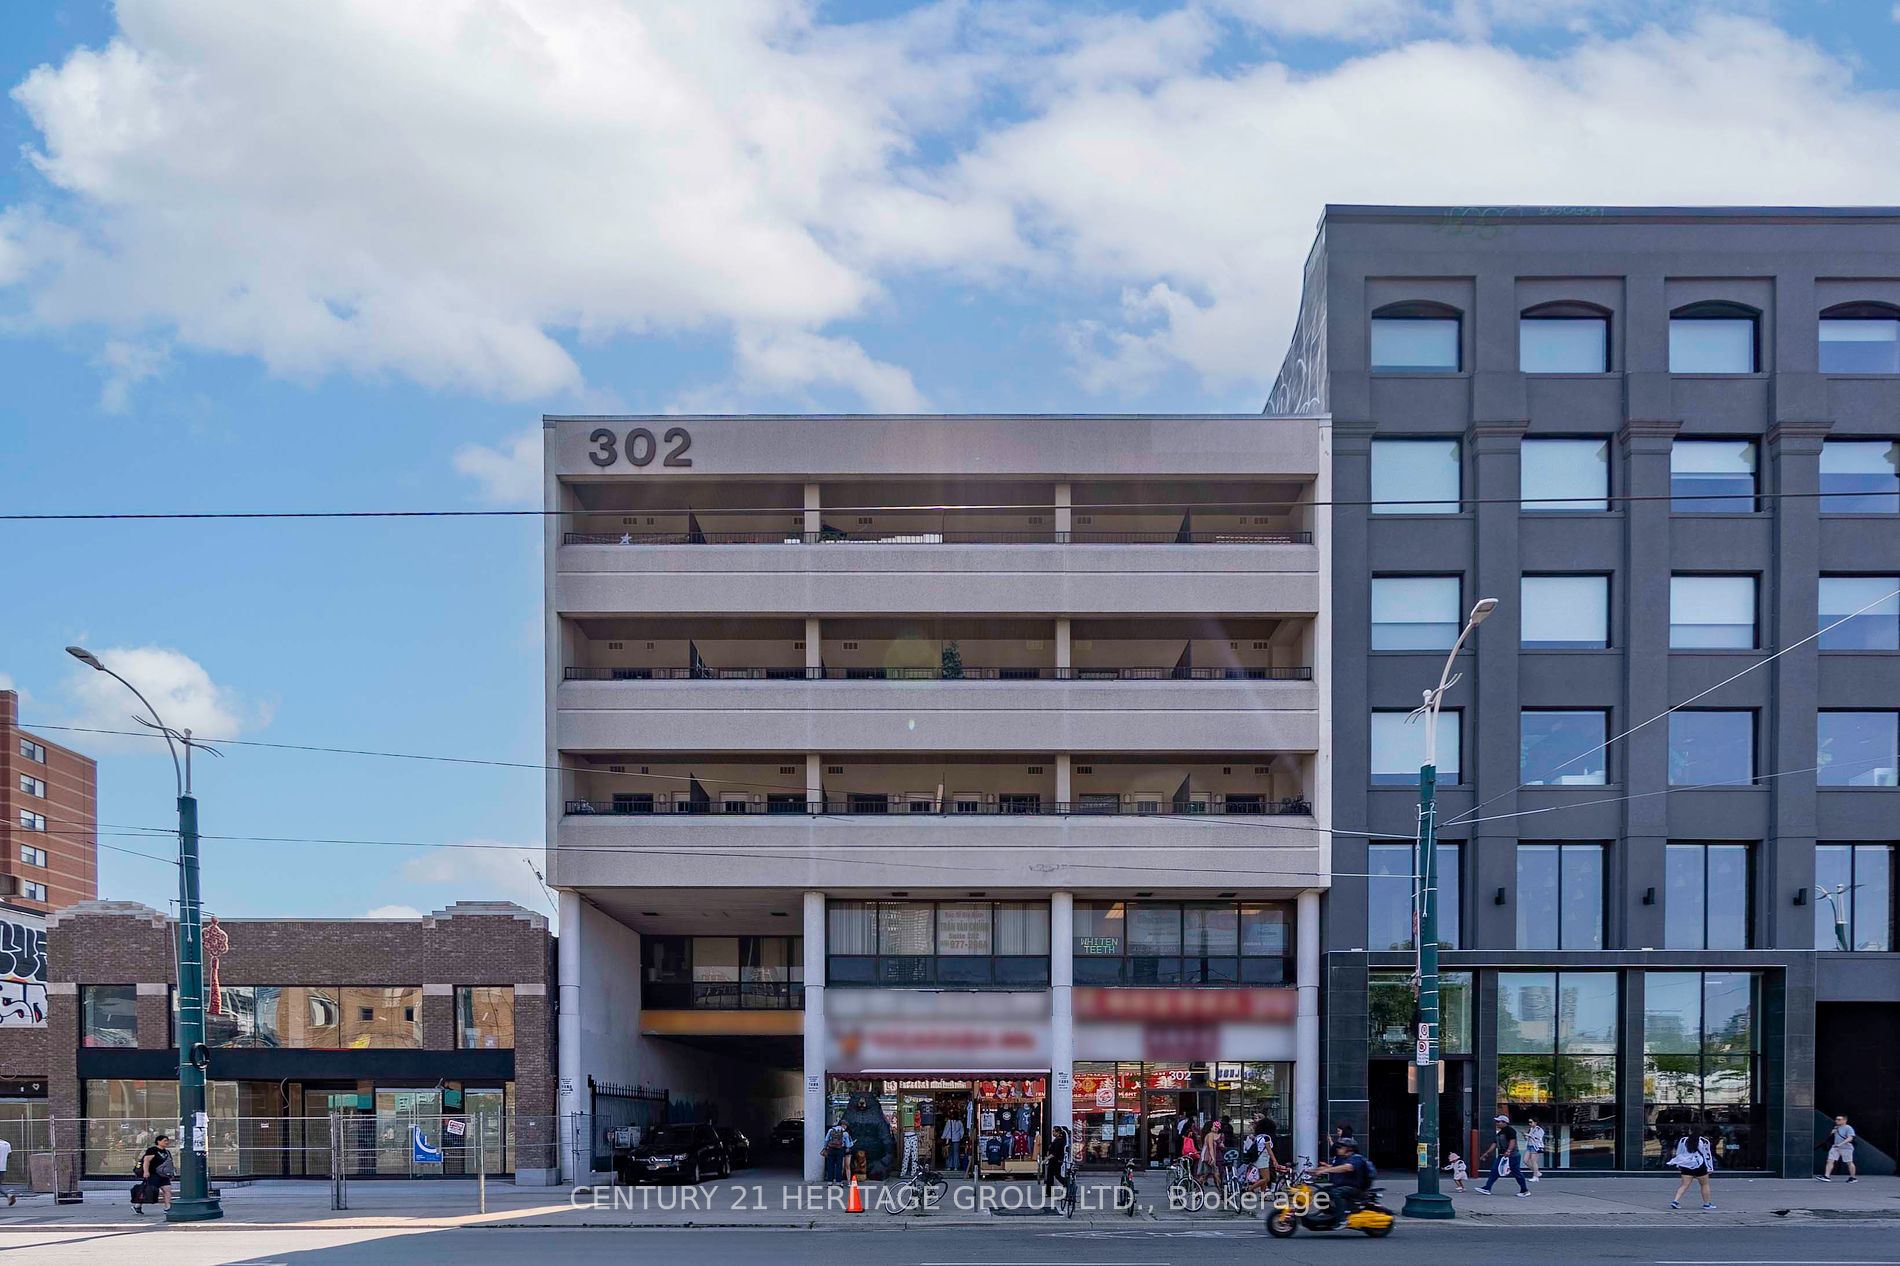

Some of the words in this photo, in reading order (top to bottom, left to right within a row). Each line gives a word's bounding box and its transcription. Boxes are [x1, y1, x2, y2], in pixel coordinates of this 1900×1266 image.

[588, 427, 693, 467] 302
[1080, 937, 1119, 946] WHITEN
[1083, 945, 1115, 954] TEETH
[1169, 1070, 1192, 1081] 302
